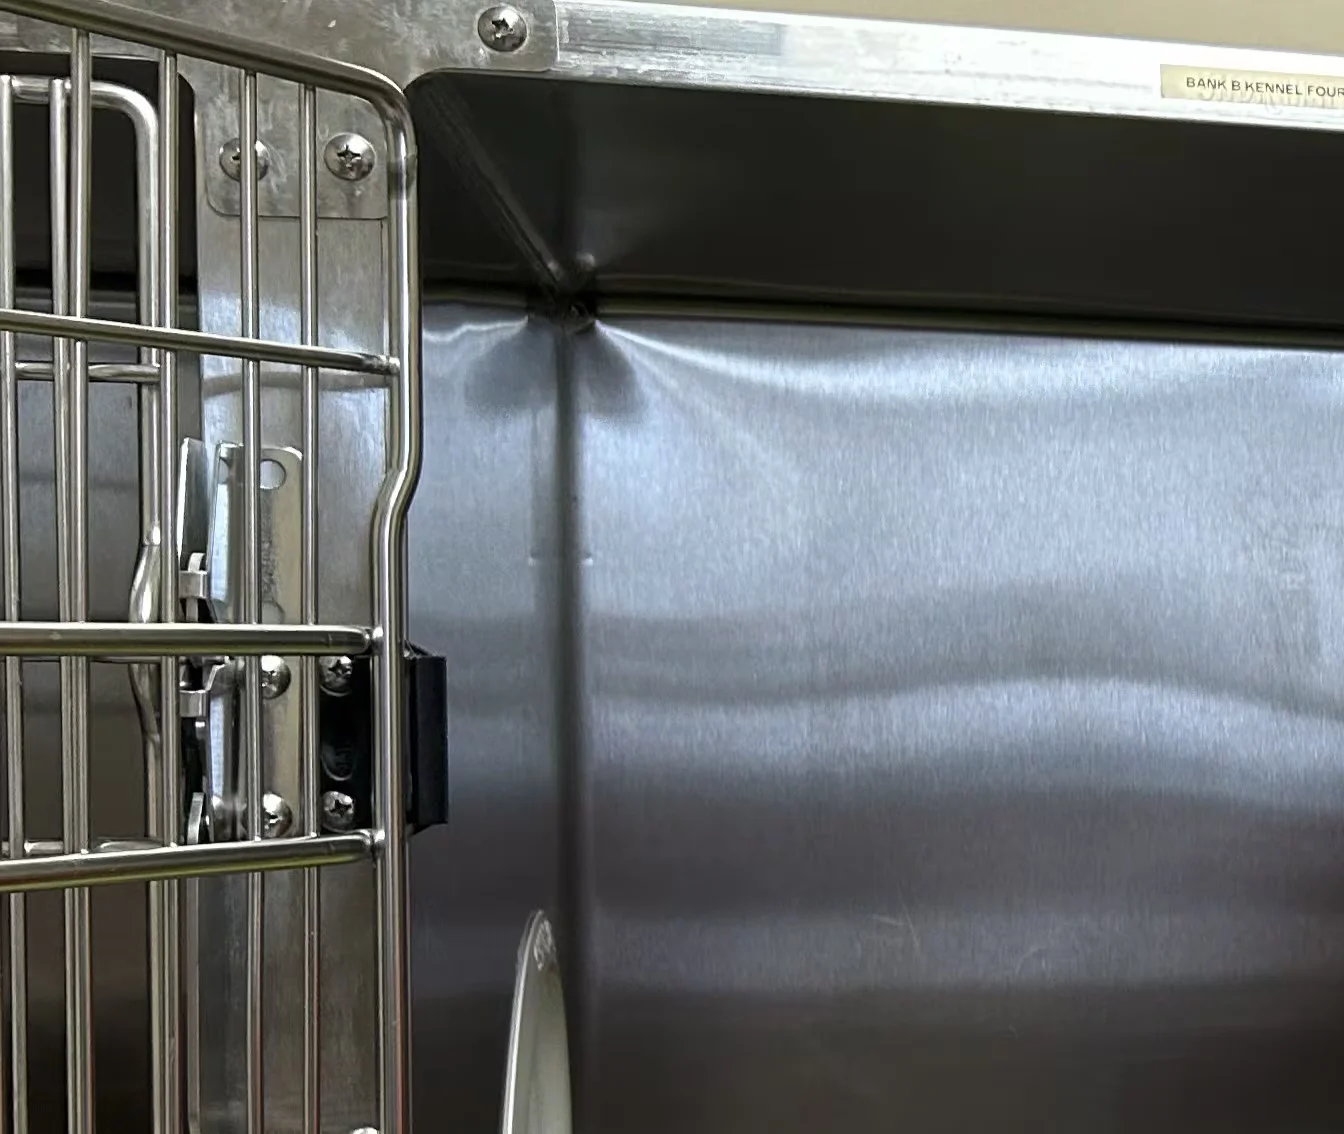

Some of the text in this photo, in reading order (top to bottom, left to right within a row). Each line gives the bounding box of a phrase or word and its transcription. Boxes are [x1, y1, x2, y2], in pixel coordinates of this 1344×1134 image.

[1186, 76, 1228, 92] BANK
[1231, 80, 1241, 92] B
[1245, 82, 1303, 96] KENNEL
